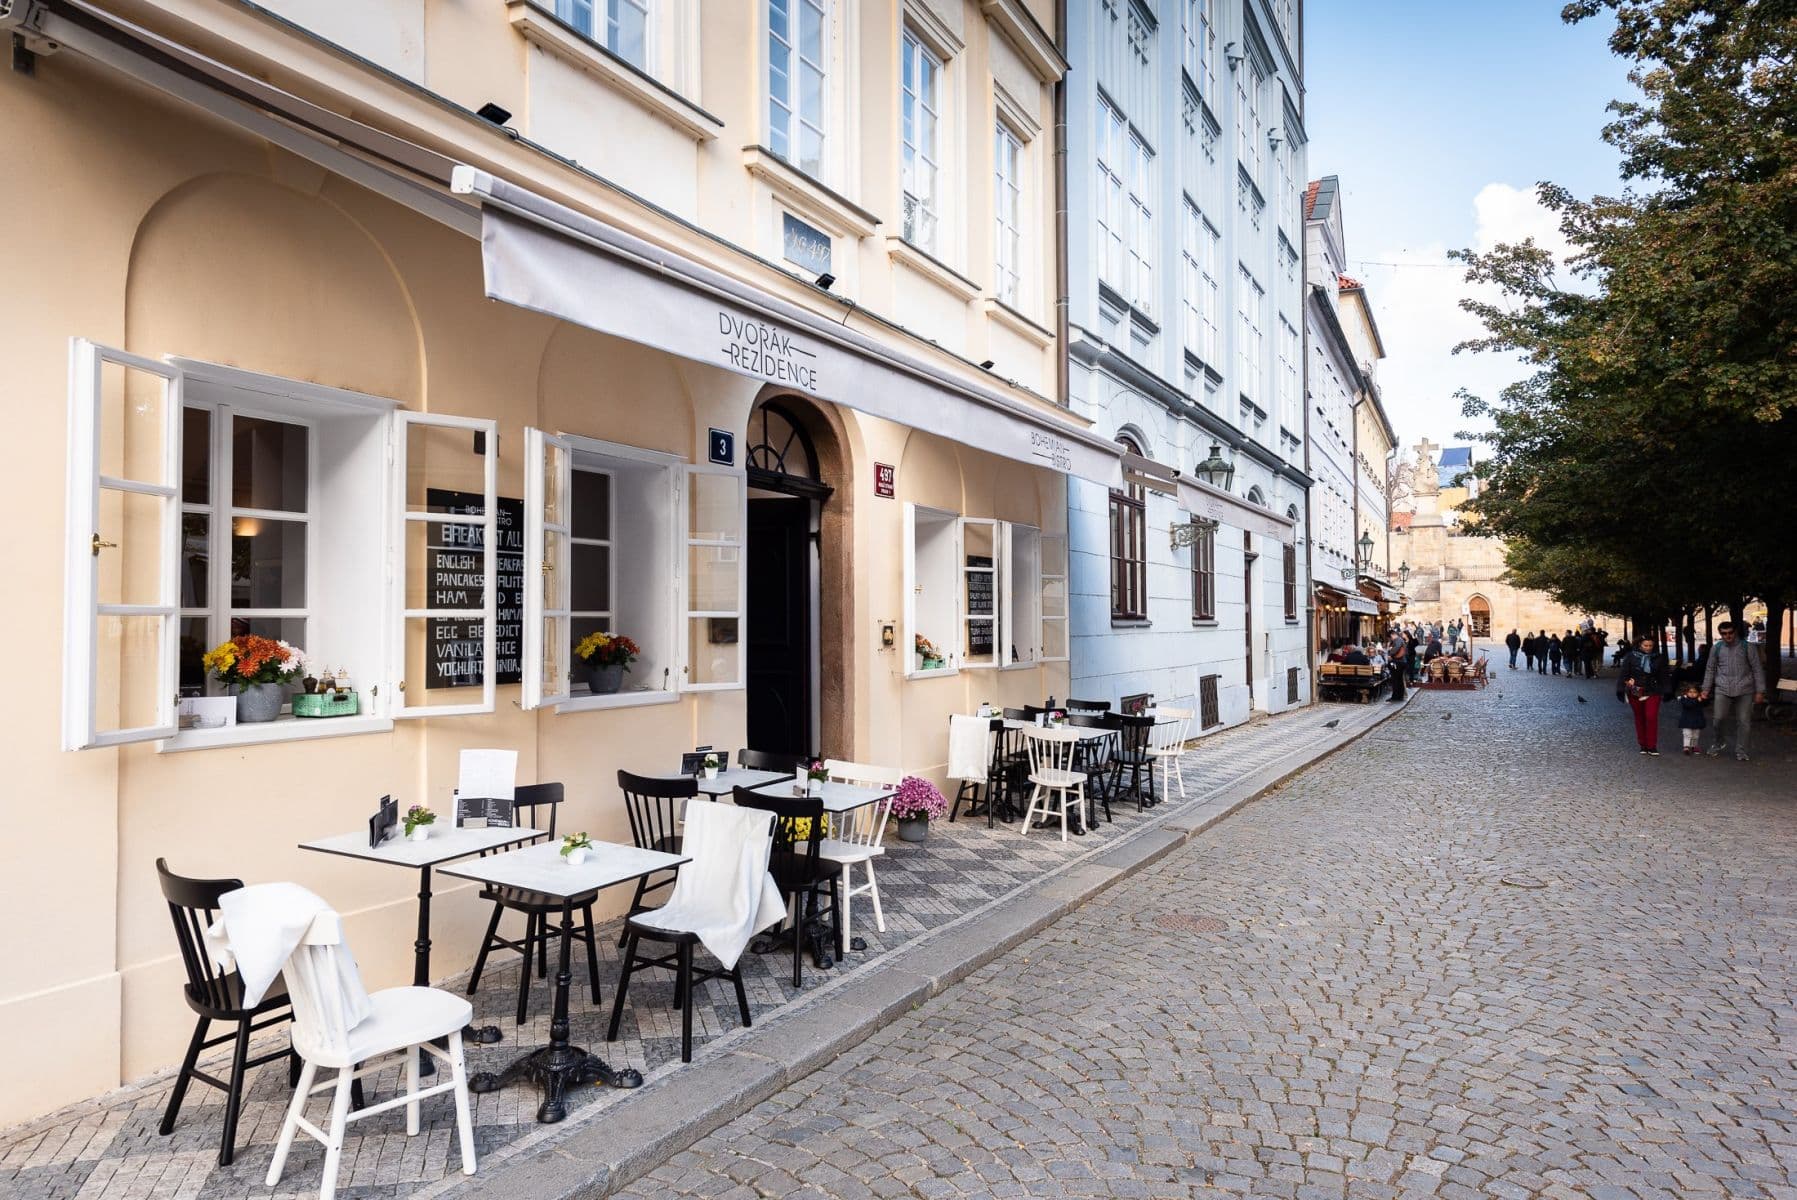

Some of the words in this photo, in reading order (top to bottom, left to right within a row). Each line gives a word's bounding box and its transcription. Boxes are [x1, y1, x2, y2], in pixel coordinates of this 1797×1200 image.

[719, 311, 792, 357] DVOŘÁK
[730, 342, 817, 391] REZIDENCE
[719, 438, 727, 455] 3
[879, 467, 892, 482] 497
[436, 590, 468, 604] HAM
[436, 625, 458, 640] EGG
